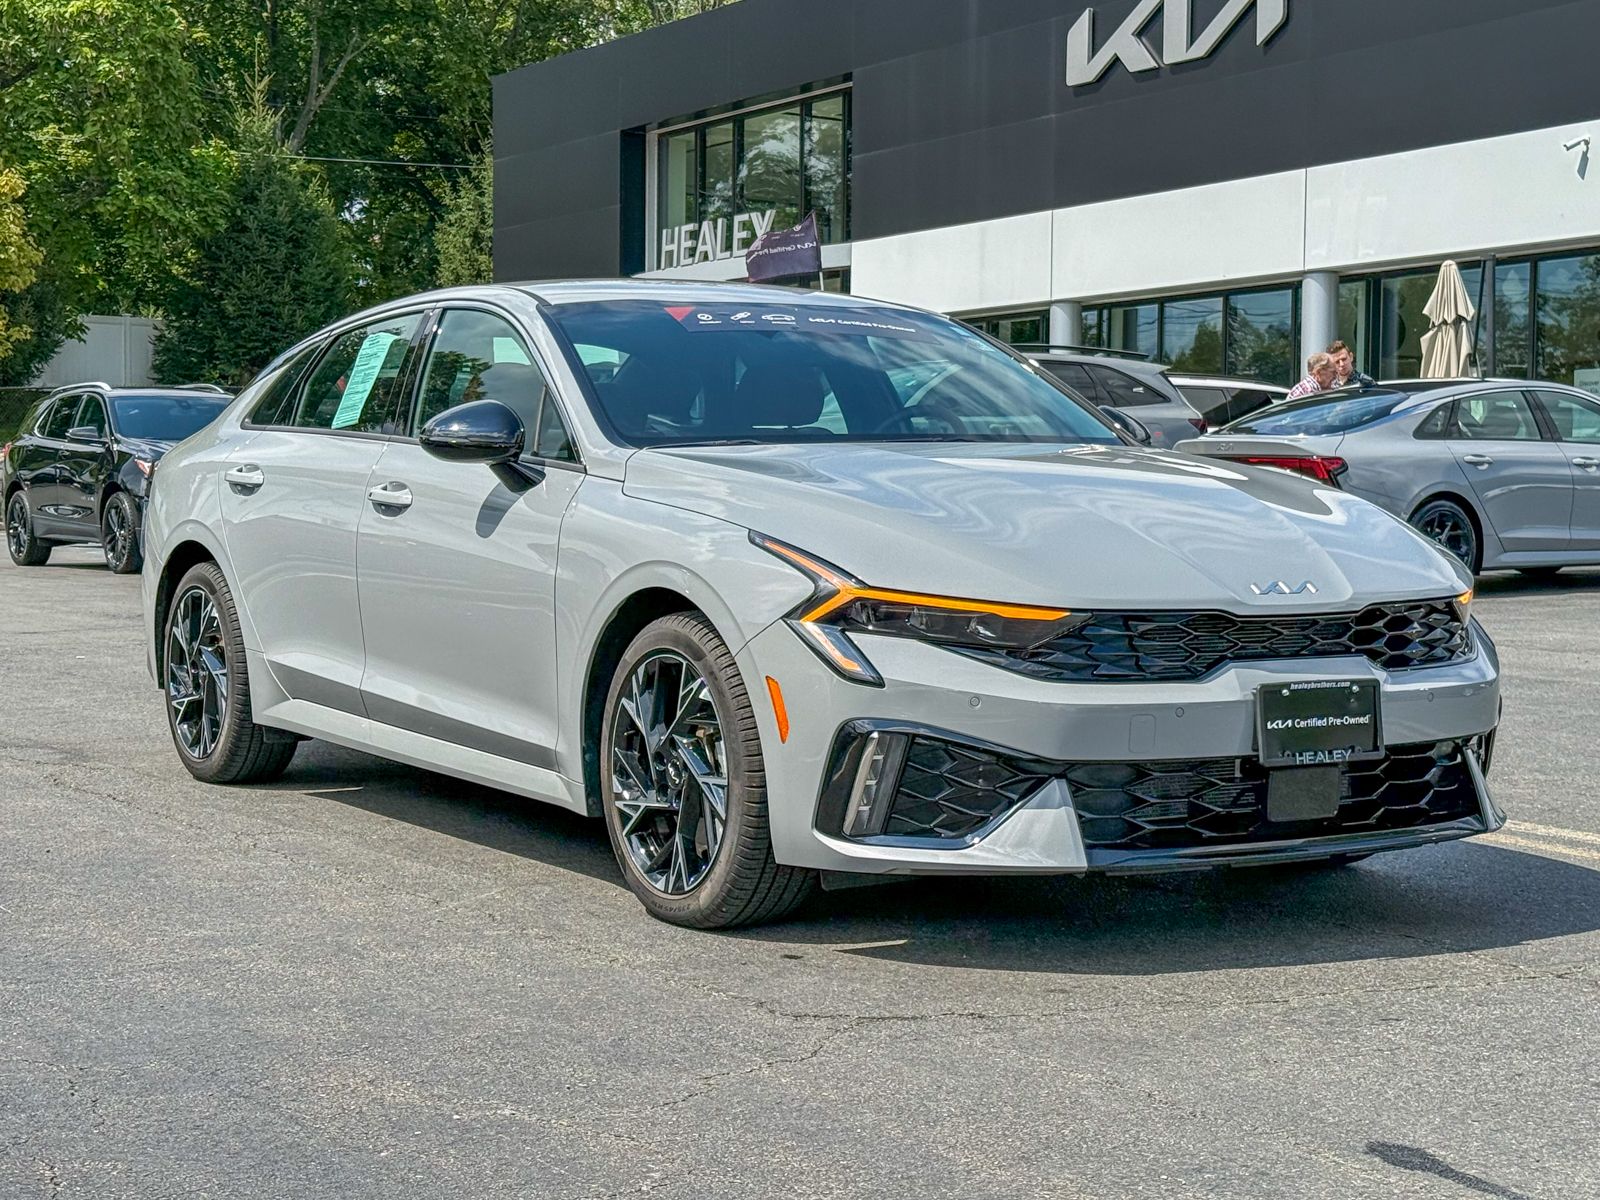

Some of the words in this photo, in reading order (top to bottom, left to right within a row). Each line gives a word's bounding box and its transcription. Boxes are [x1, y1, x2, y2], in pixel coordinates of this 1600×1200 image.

[1065, 0, 1288, 87] KIA
[661, 209, 776, 270] HEALEY
[1250, 580, 1319, 595] KIA
[1290, 681, 1351, 690] healeybrothers.com
[1266, 719, 1292, 730] KIA
[1294, 717, 1327, 728] Certified
[1295, 749, 1352, 765] HEALEY
